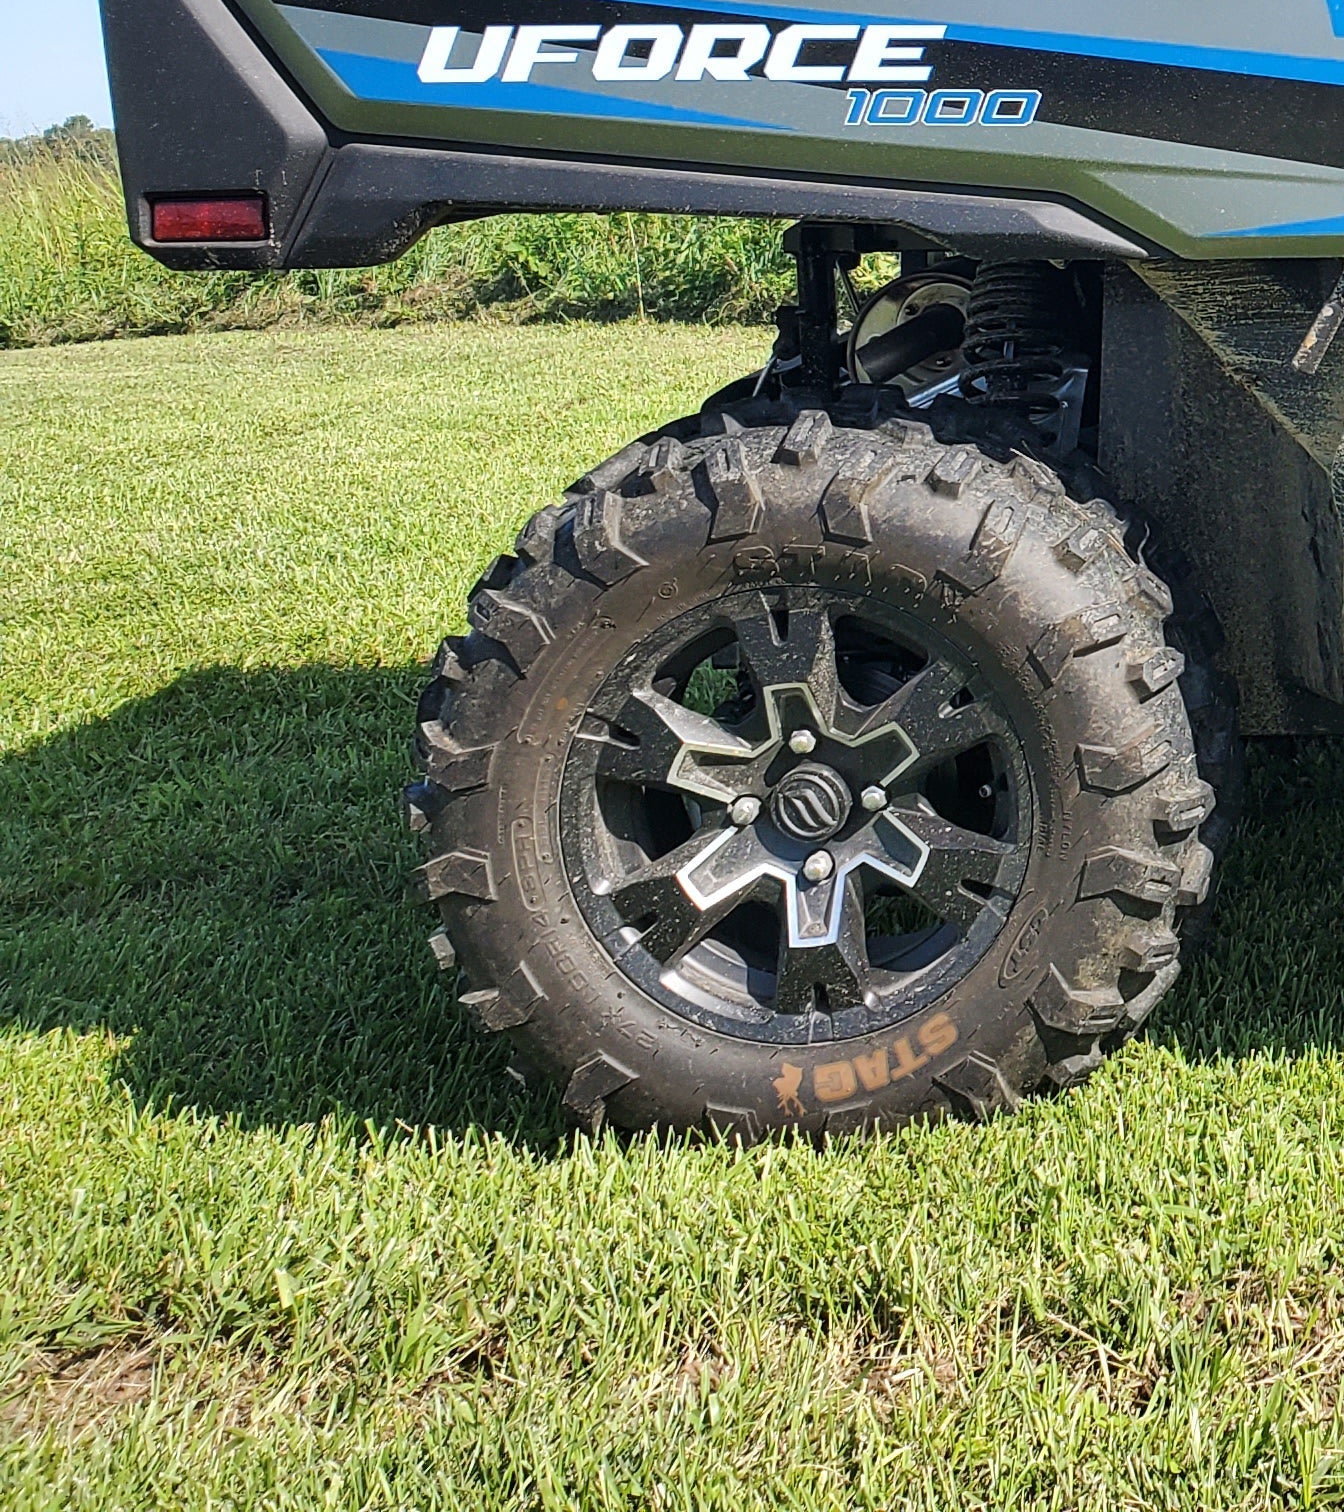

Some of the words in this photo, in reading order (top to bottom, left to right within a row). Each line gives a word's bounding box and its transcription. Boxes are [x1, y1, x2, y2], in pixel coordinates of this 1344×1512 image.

[417, 24, 948, 83] UFORCE
[844, 88, 1042, 127] 1000
[813, 1012, 960, 1104] STAG
